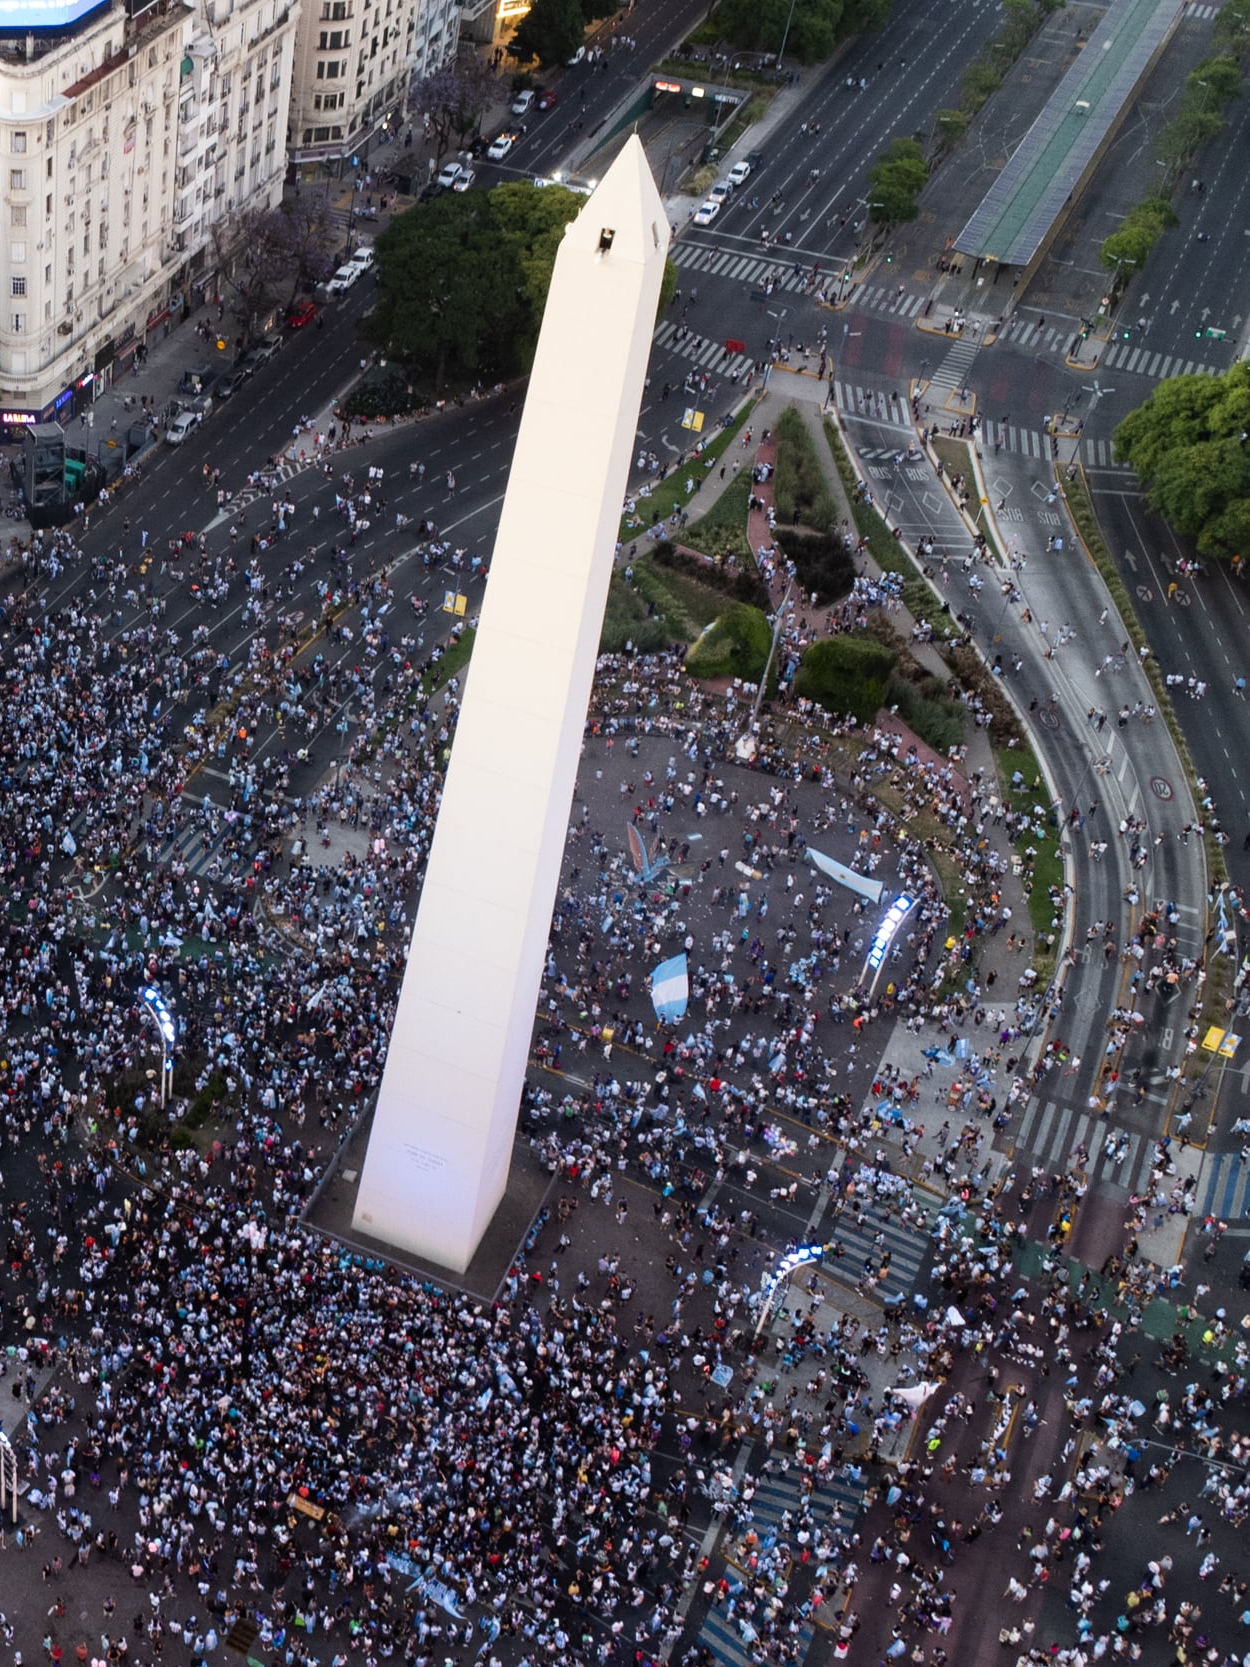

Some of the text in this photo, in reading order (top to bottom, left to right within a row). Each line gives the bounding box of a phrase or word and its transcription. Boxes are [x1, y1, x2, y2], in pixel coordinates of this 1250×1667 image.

[868, 466, 892, 480] BUS
[905, 467, 930, 481] BUS
[1038, 511, 1062, 526] BUS
